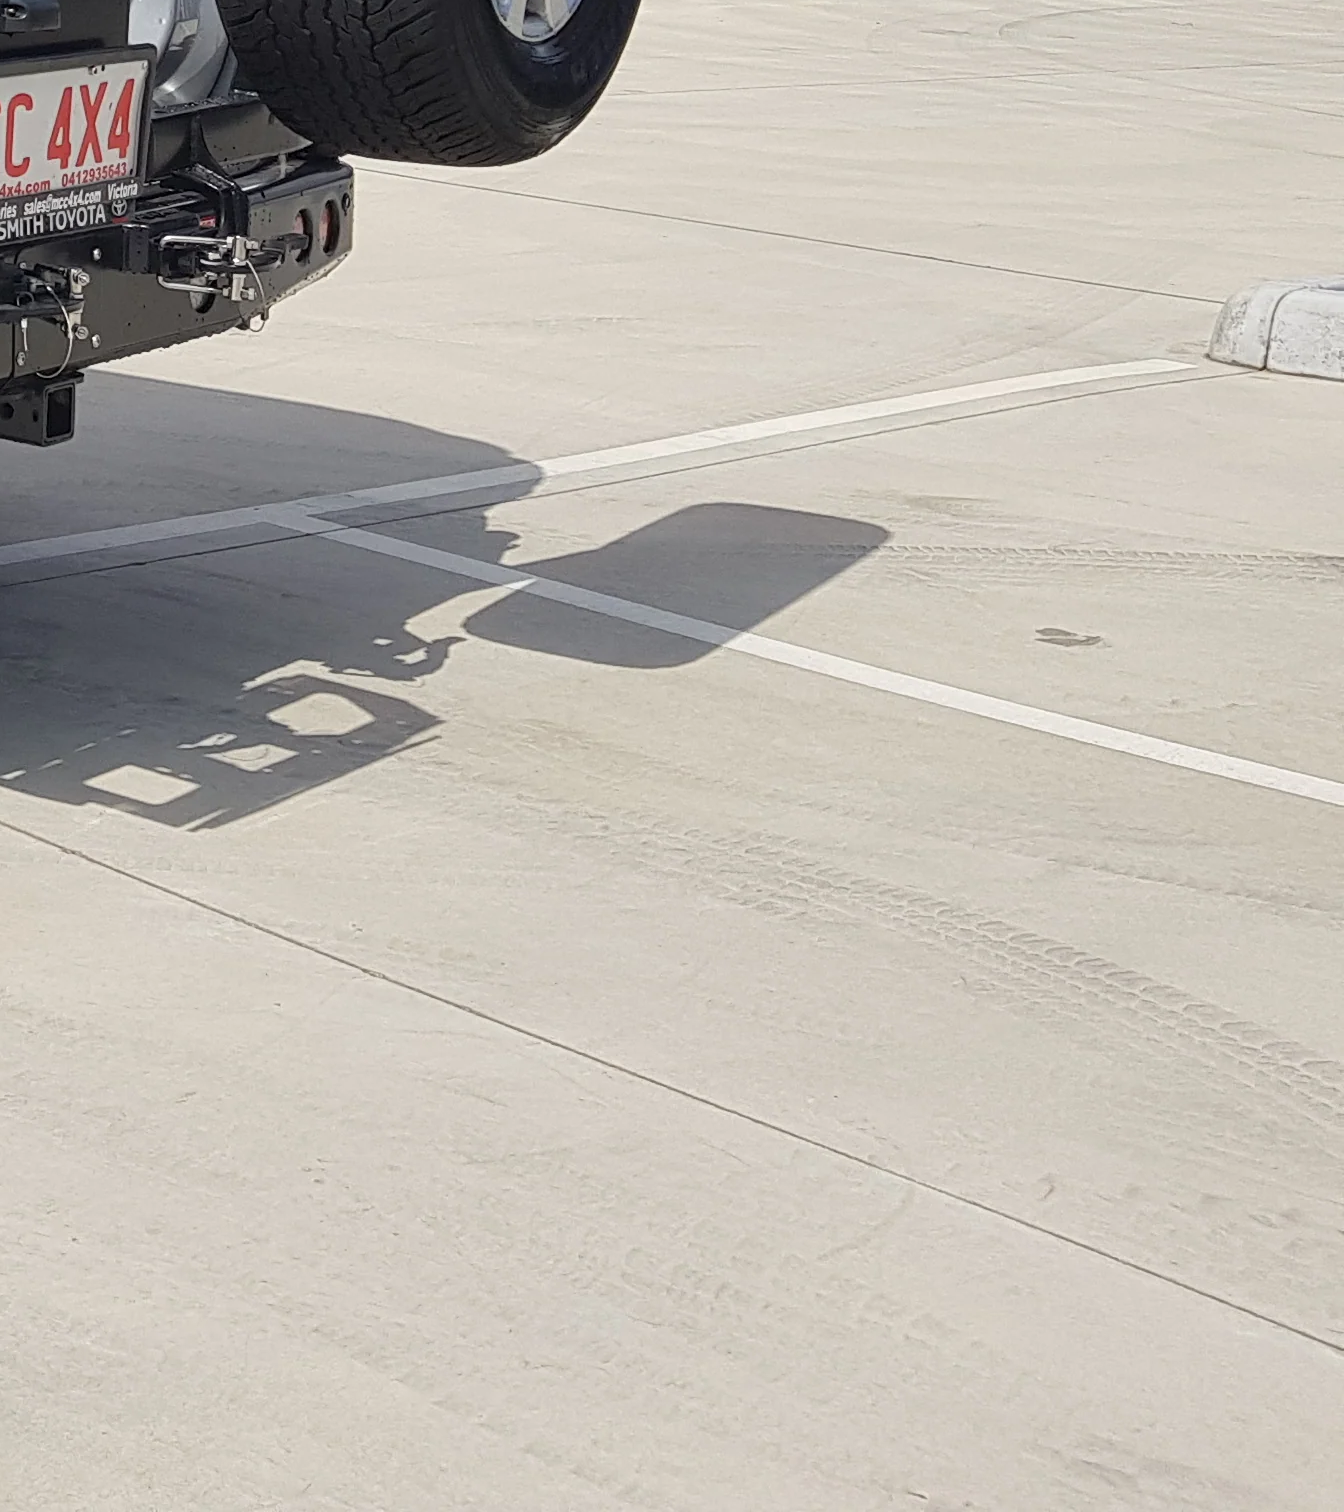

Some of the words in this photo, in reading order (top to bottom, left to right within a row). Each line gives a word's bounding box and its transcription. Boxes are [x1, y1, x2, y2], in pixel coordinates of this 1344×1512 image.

[46, 78, 135, 170] 4X4
[107, 179, 138, 201] Victoria
[47, 203, 106, 232] TOYOTA
